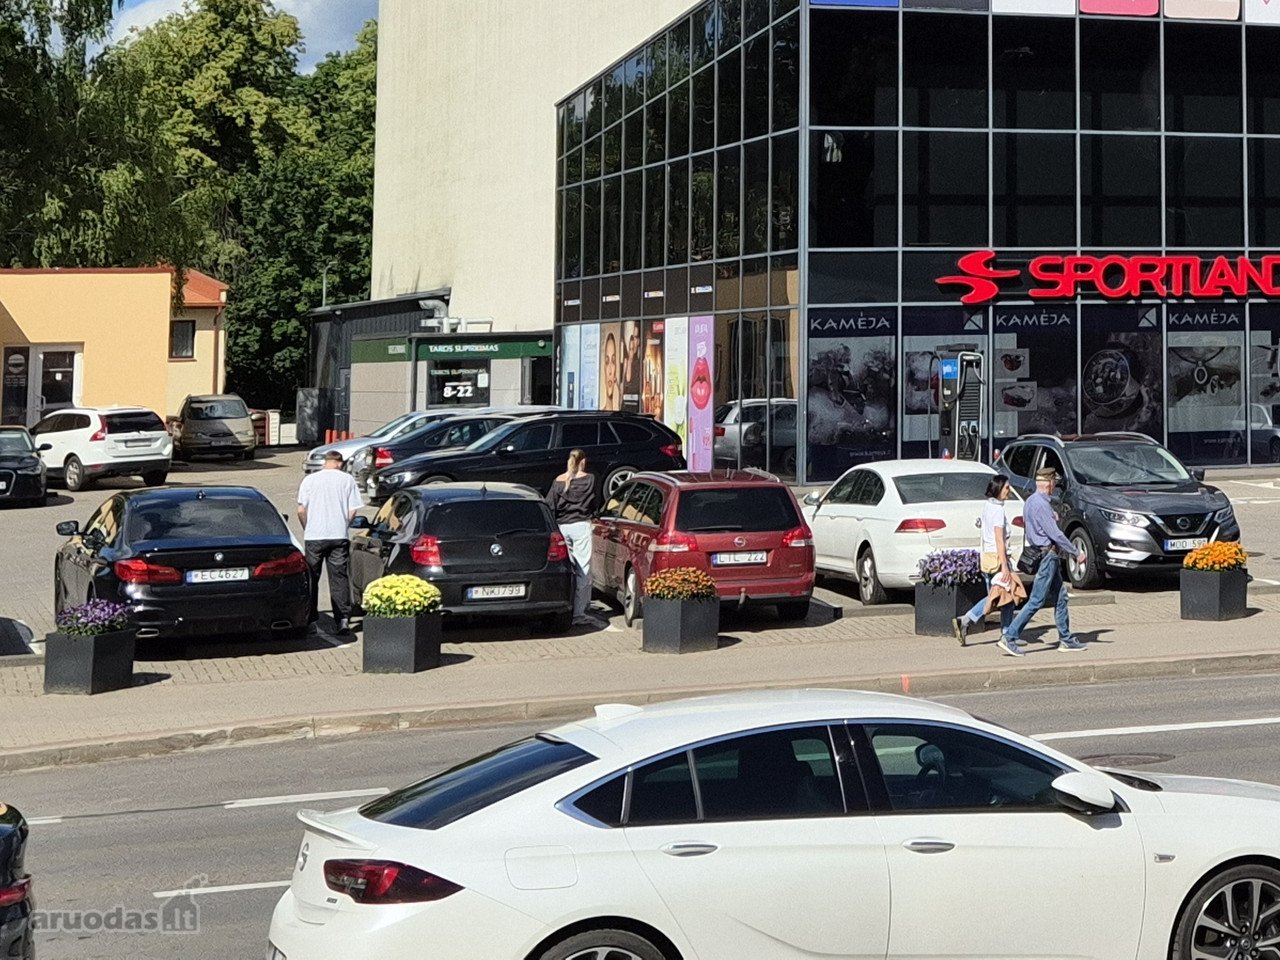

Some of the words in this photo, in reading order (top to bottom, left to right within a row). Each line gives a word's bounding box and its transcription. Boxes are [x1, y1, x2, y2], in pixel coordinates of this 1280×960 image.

[810, 311, 891, 330] KAMĖJA
[995, 308, 1072, 326] KAMĖJA
[1168, 307, 1240, 325] KAMĖJA
[443, 385, 474, 398] 8-22
